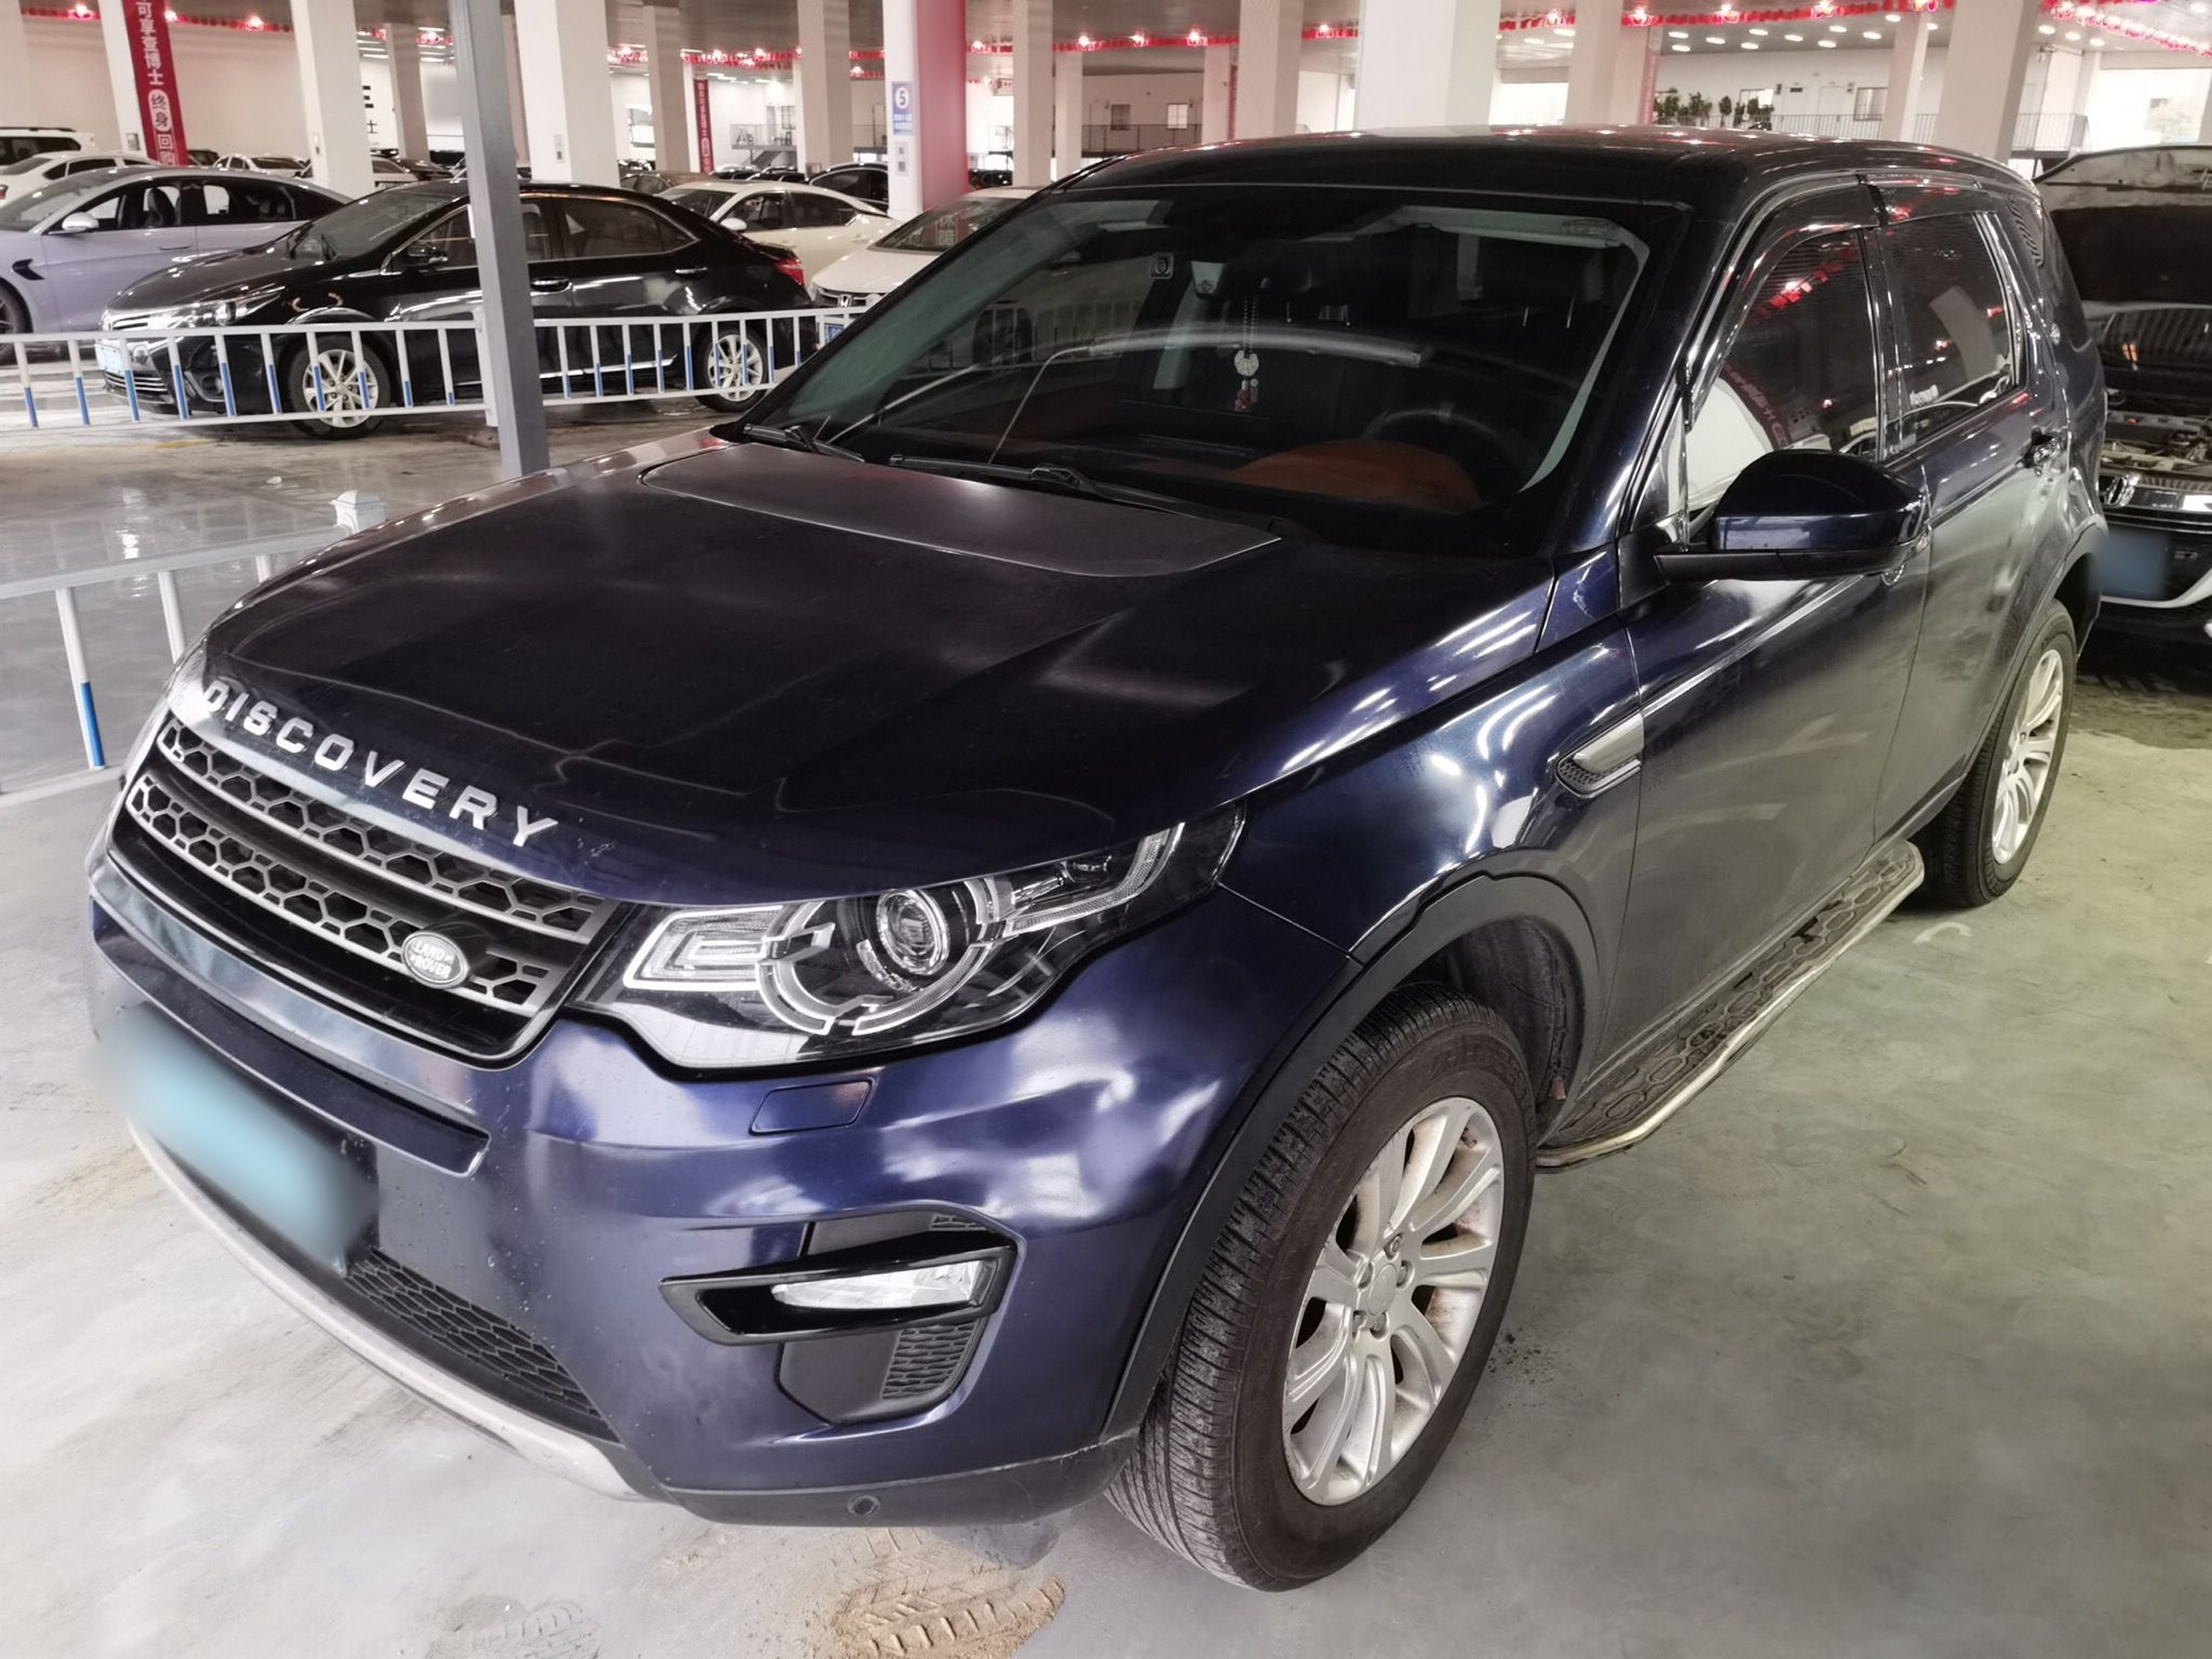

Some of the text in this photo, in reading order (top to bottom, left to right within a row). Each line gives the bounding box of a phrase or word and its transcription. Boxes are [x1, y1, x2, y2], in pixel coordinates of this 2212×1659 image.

[136, 0, 176, 165] 可享查博士终身回购
[204, 680, 559, 847] DISCOVERY
[414, 956, 452, 978] ROVER
[415, 941, 446, 961] LAND
